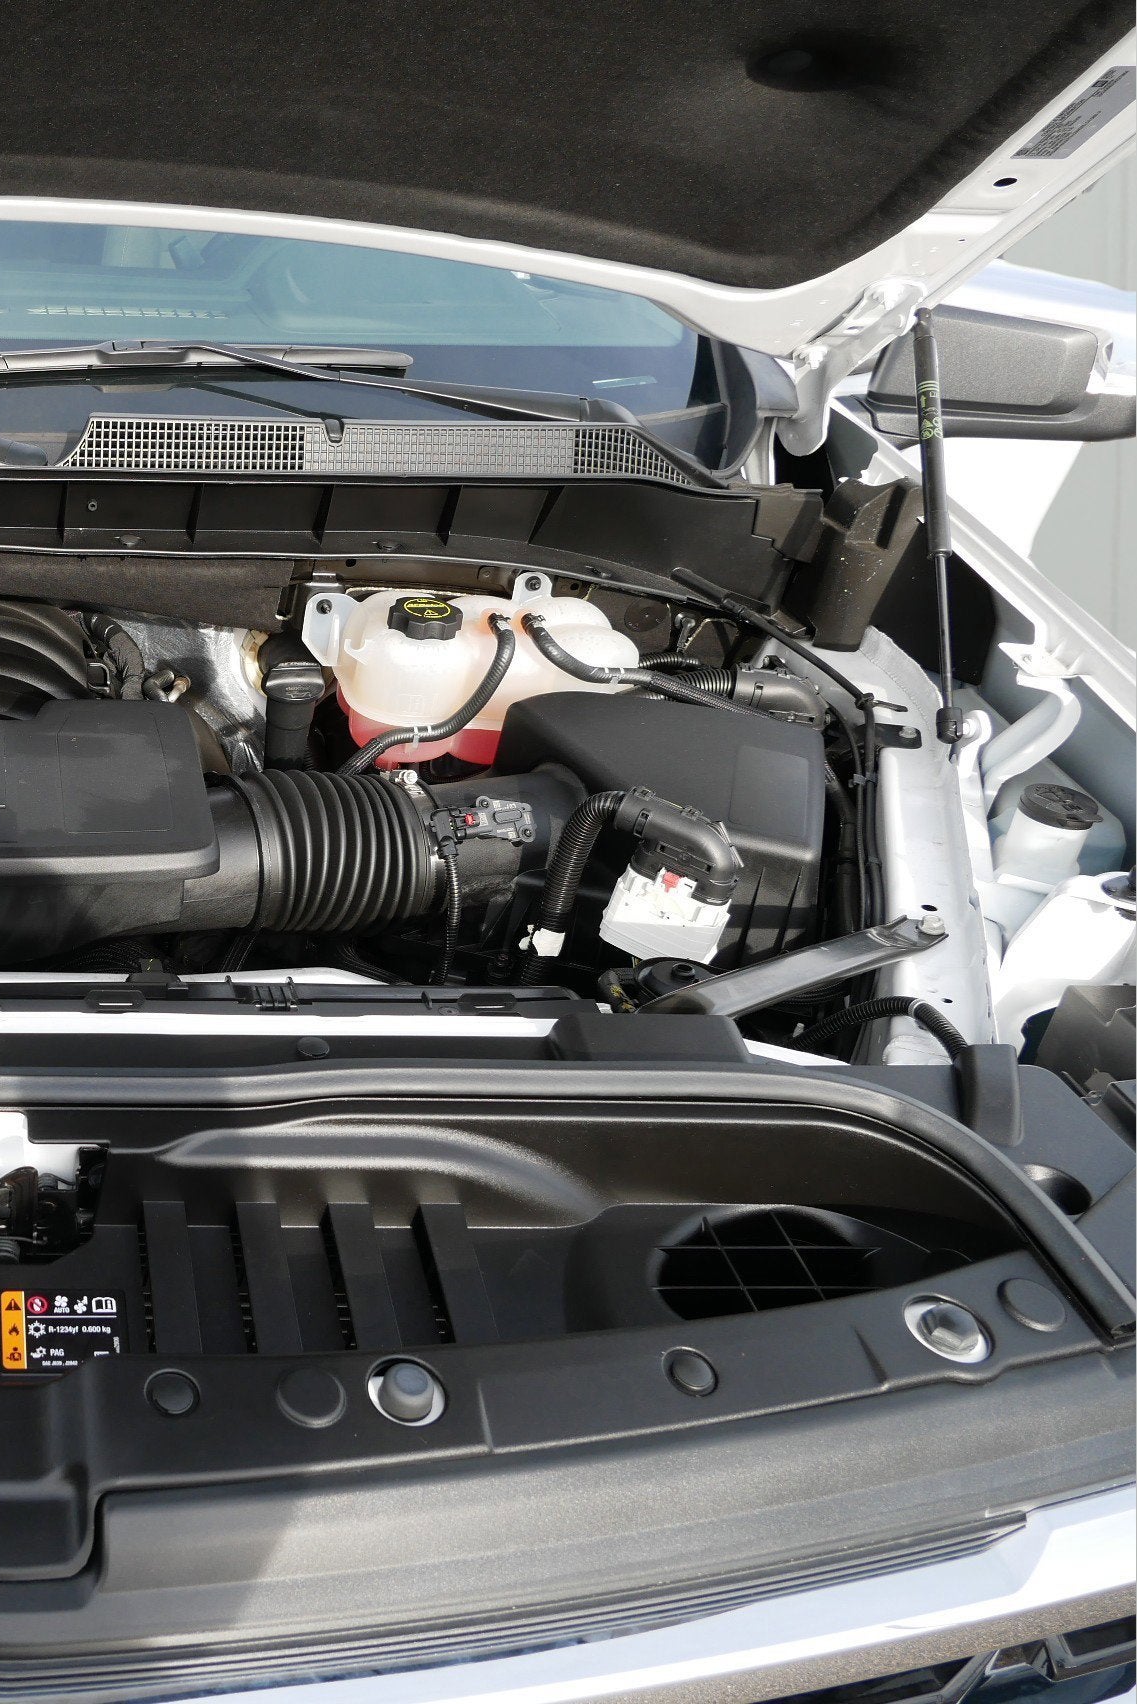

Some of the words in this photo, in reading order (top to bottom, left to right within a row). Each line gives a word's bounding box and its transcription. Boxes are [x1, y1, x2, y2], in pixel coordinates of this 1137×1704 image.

[48, 1325, 79, 1335] R-1234yf
[82, 1325, 101, 1333] 0.600
[102, 1325, 111, 1334] kg
[50, 1348, 65, 1357] PAG
